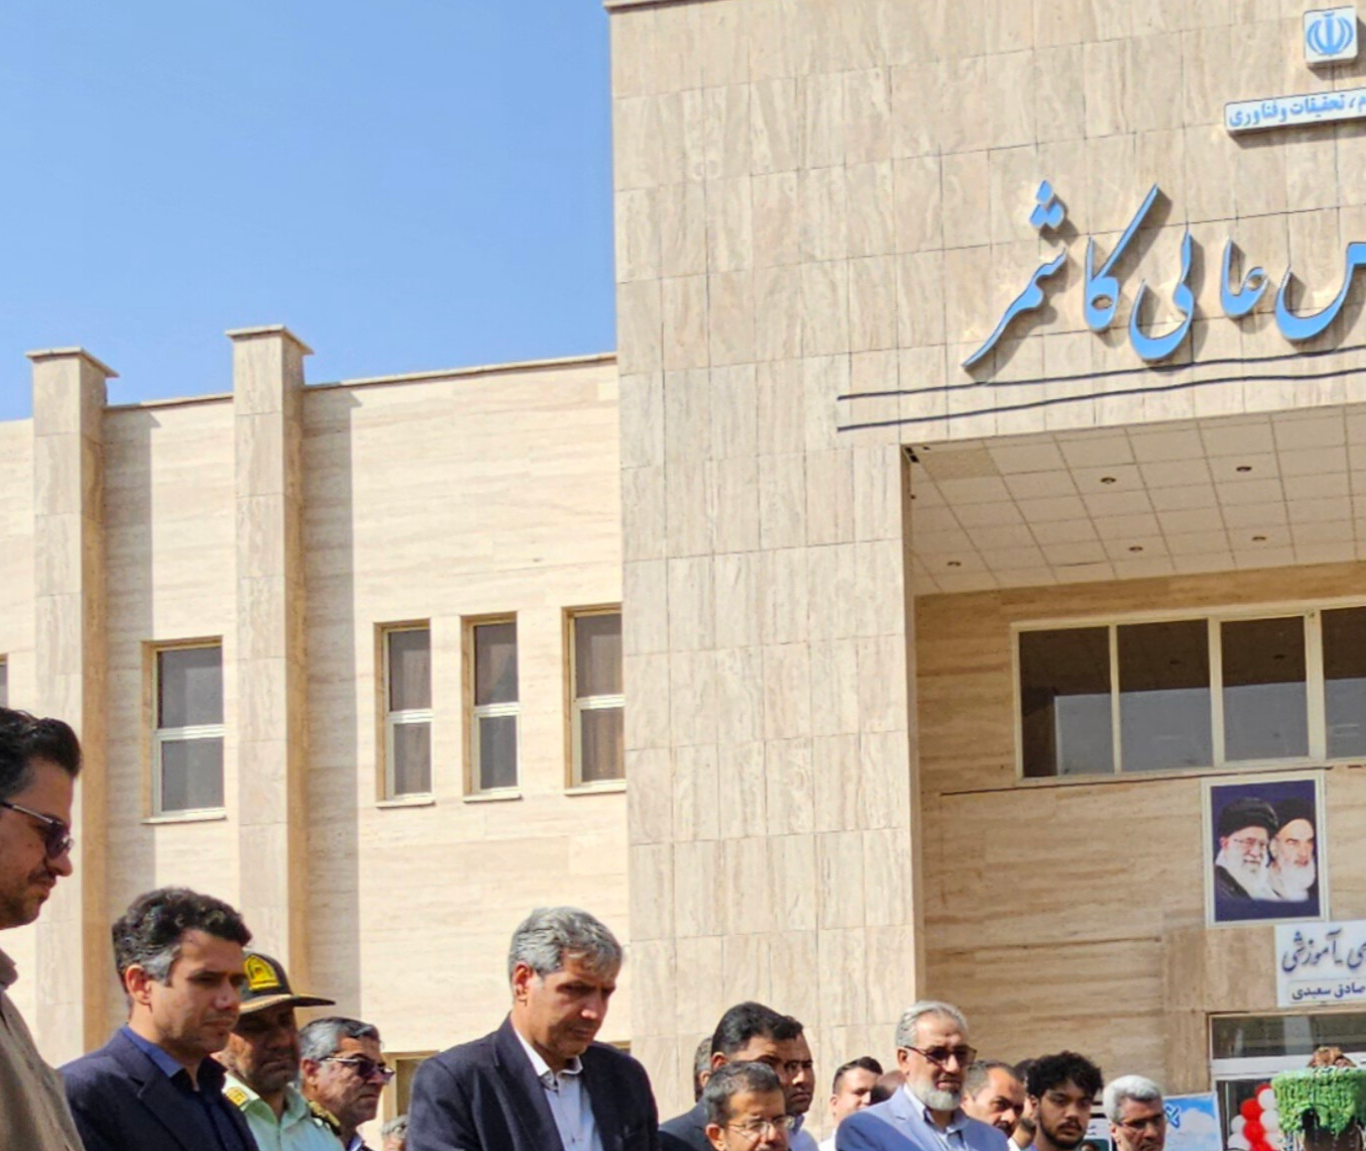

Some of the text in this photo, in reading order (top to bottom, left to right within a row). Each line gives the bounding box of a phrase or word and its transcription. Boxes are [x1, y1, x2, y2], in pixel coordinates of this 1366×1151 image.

[1290, 93, 1345, 118] تحقیقات
[963, 180, 1158, 367] کاشمر
[1128, 233, 1268, 361] عالی
[1281, 927, 1343, 973] آموزشی
[1291, 987, 1332, 1001] سعیدی
[1334, 982, 1366, 999] صادق
